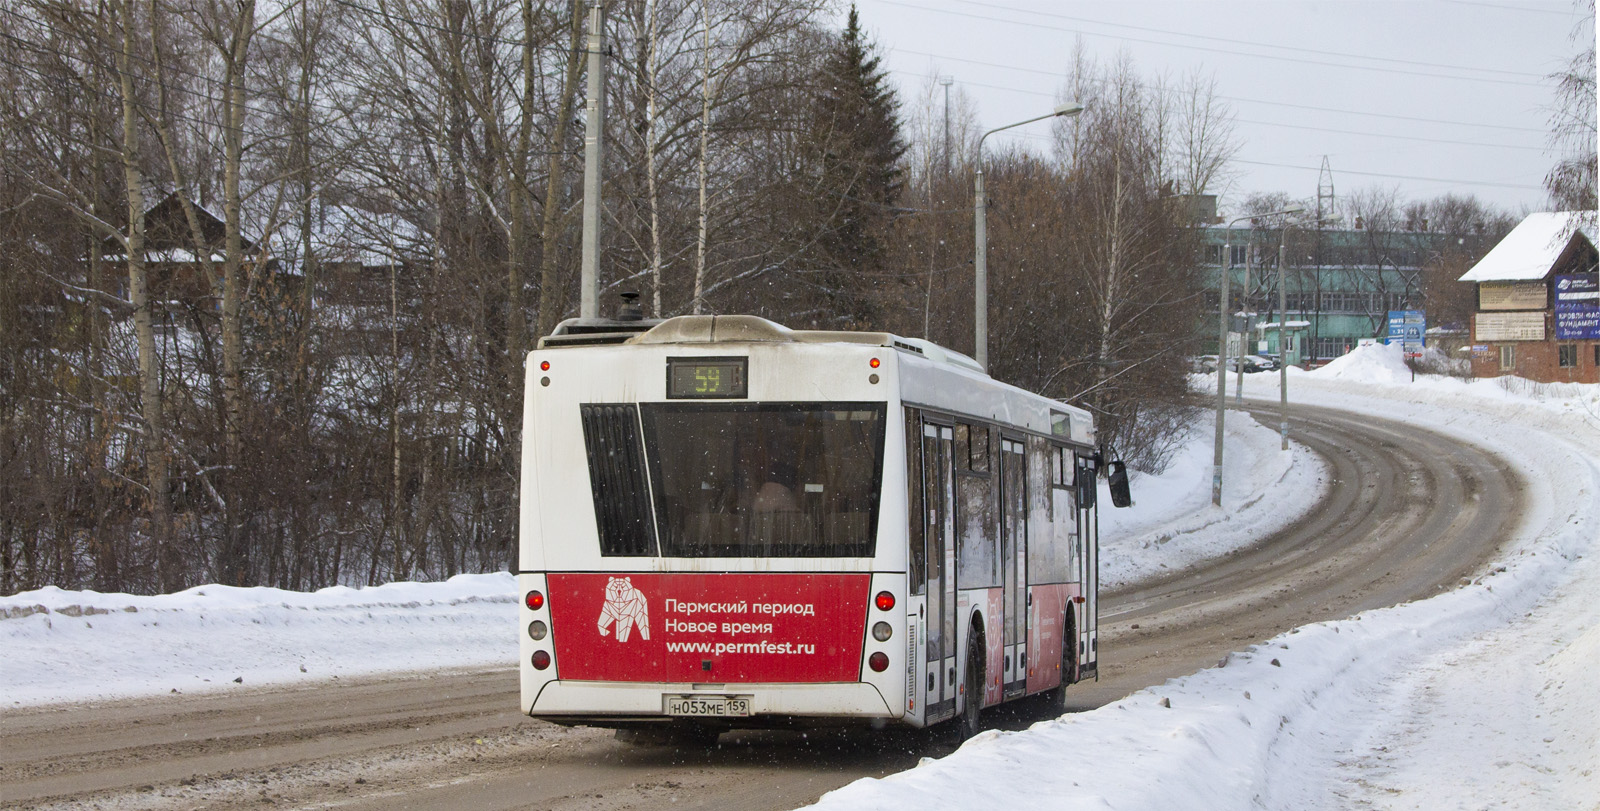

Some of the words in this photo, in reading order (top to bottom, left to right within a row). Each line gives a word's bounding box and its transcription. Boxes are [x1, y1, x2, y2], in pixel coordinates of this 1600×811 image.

[695, 366, 720, 392] 59
[664, 598, 748, 616] Пермский
[752, 603, 815, 617] период
[664, 618, 717, 633] Новое
[721, 622, 773, 636] время
[666, 640, 815, 656] www.permfest.ru
[726, 700, 746, 712] 159
